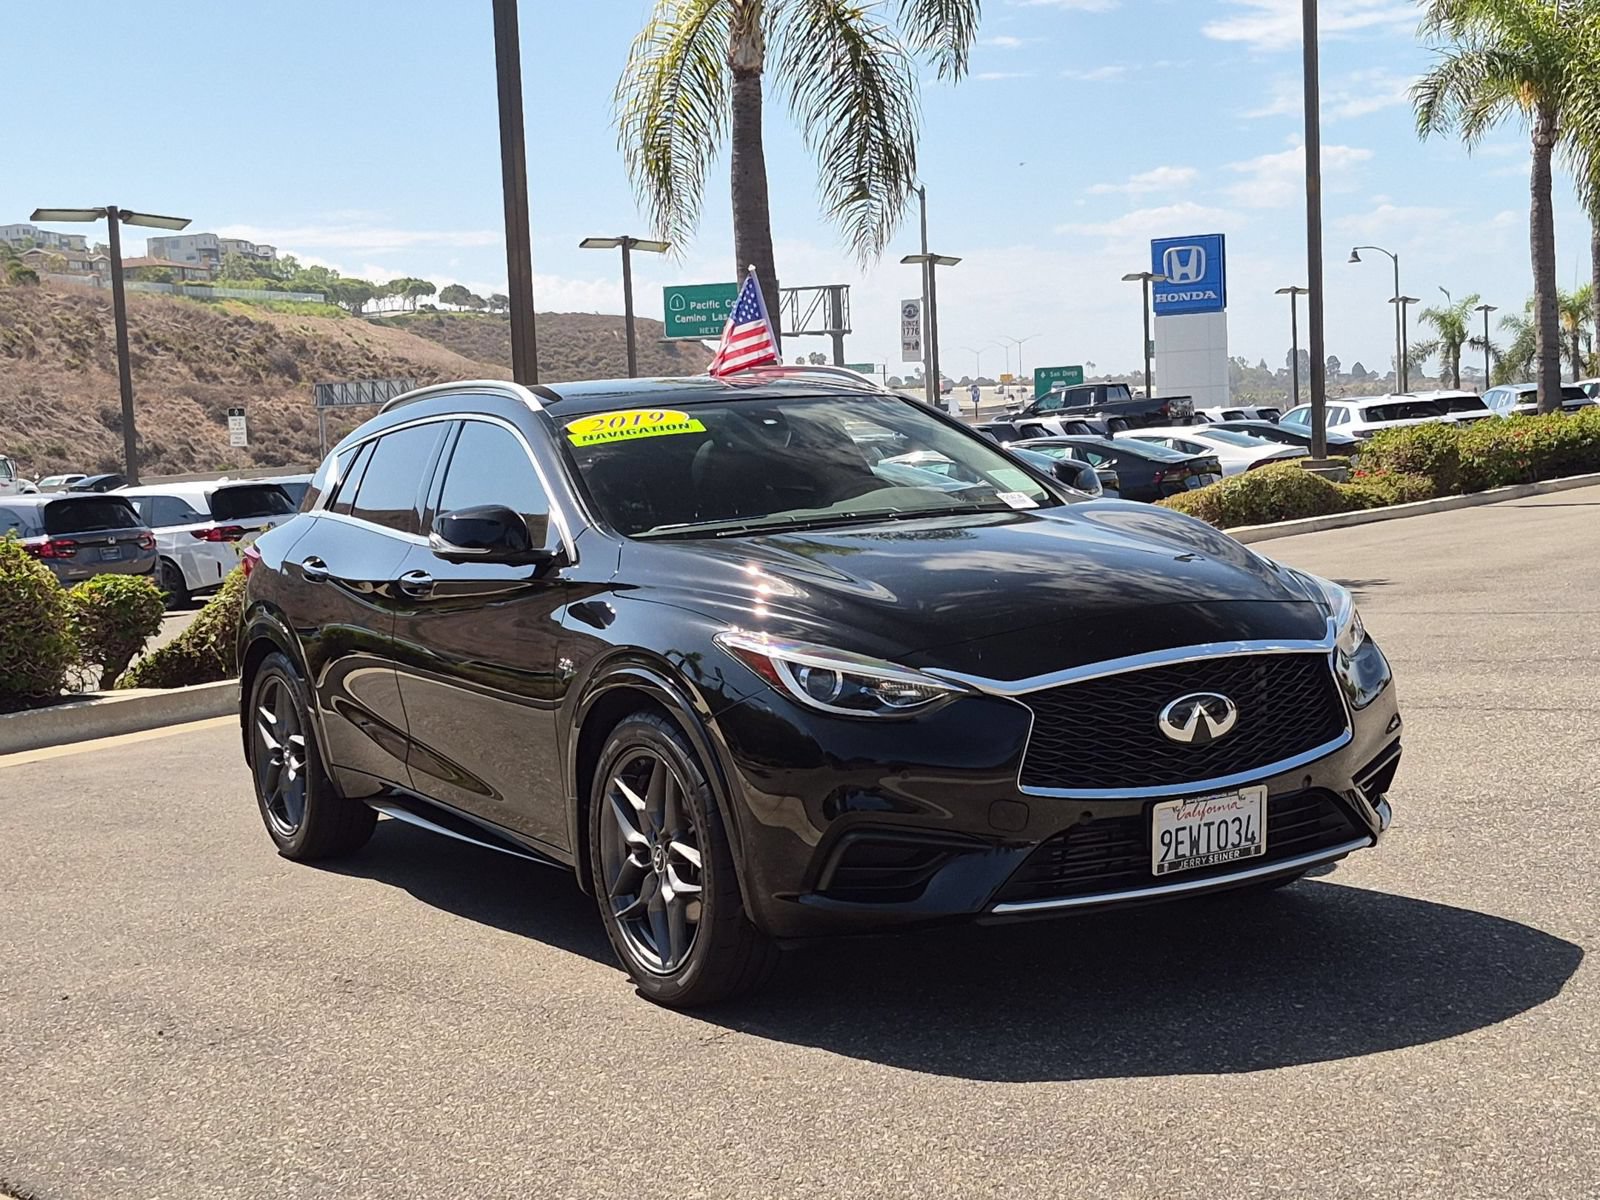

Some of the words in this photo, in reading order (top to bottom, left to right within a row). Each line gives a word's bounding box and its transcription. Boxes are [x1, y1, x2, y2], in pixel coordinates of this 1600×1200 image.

[690, 300, 720, 310] Pacific
[725, 299, 737, 308] Co
[1155, 290, 1217, 303] HONDA
[675, 314, 706, 323] Camino
[712, 312, 727, 321] Las
[699, 326, 720, 335] NEXT
[902, 327, 920, 336] 1776
[591, 411, 665, 432] 2019
[582, 422, 690, 442] NAVIGATION
[1176, 800, 1244, 821] California
[1159, 814, 1257, 862] 9EWT034
[1180, 857, 1207, 869] JERRY
[1208, 850, 1241, 863] SEINER
